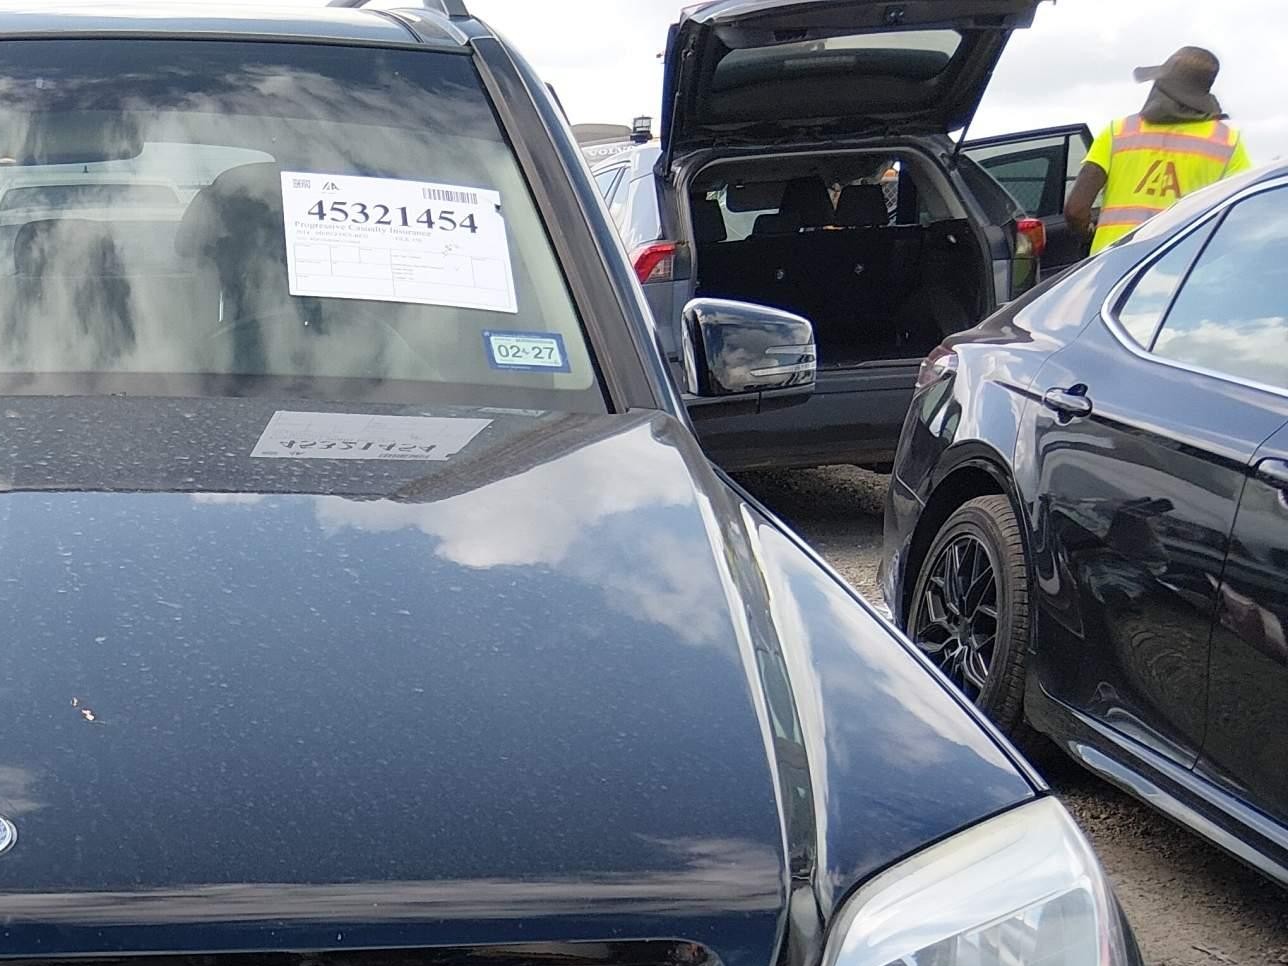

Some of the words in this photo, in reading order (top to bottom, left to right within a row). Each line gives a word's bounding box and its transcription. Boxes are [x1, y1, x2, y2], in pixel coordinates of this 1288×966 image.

[307, 199, 478, 233] 45321454
[294, 221, 346, 232] Progressive
[348, 224, 387, 234] Casualty
[389, 226, 432, 237] Insurance
[497, 344, 523, 359] 02
[531, 346, 554, 360] 27
